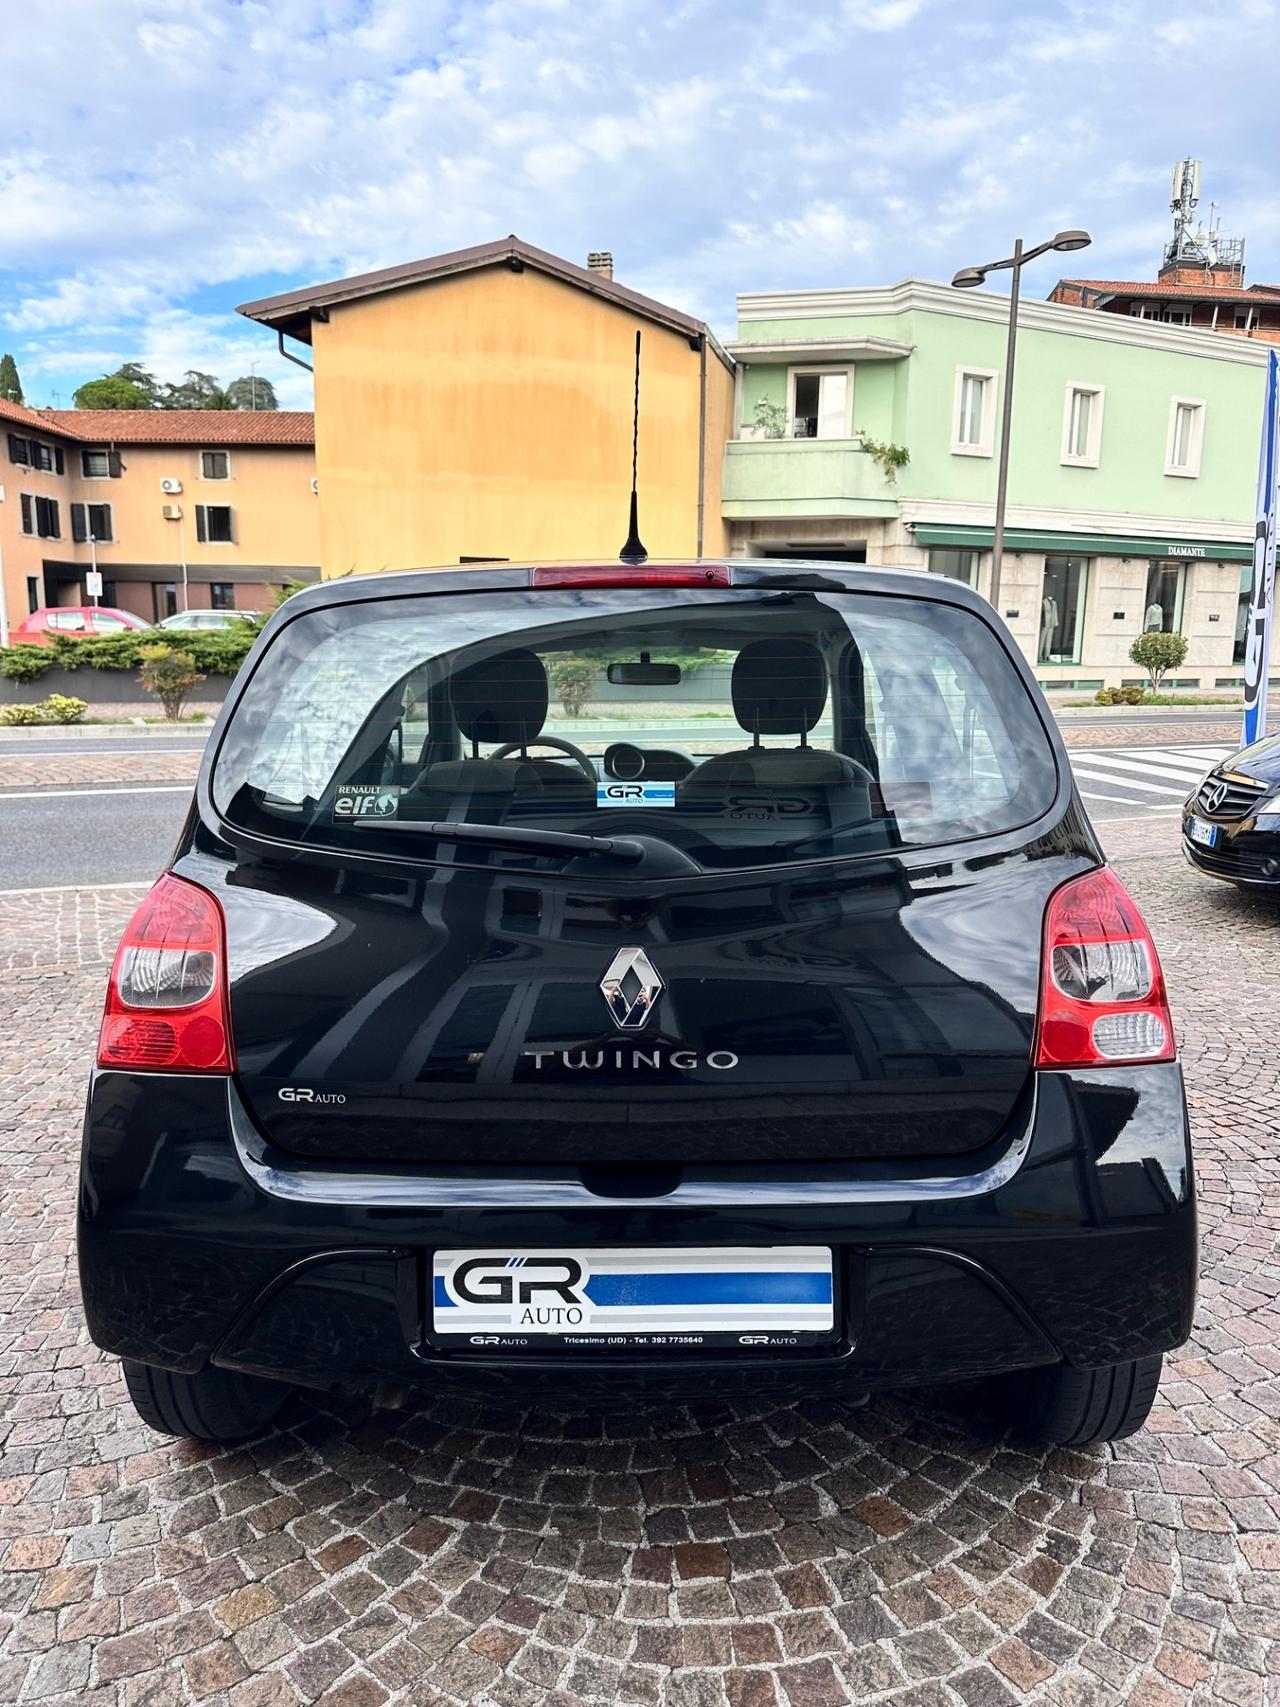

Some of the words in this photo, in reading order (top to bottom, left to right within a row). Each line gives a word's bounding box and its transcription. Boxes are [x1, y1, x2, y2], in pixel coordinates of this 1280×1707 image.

[1168, 546, 1206, 557] DIAMANTE
[338, 786, 381, 794] RENAULT
[607, 785, 642, 798] GR
[334, 796, 375, 814] elf
[522, 1050, 739, 1069] TWINGO
[278, 1088, 314, 1102] GR
[314, 1094, 346, 1104] AUTO
[453, 1257, 582, 1304] GR
[520, 1307, 583, 1325] AUTO
[470, 1336, 500, 1345] GR
[607, 1336, 627, 1345] (UD)
[634, 1336, 649, 1344] Tel.
[651, 1336, 669, 1344] 392
[669, 1336, 703, 1344] 7735640
[739, 1335, 769, 1345] GR
